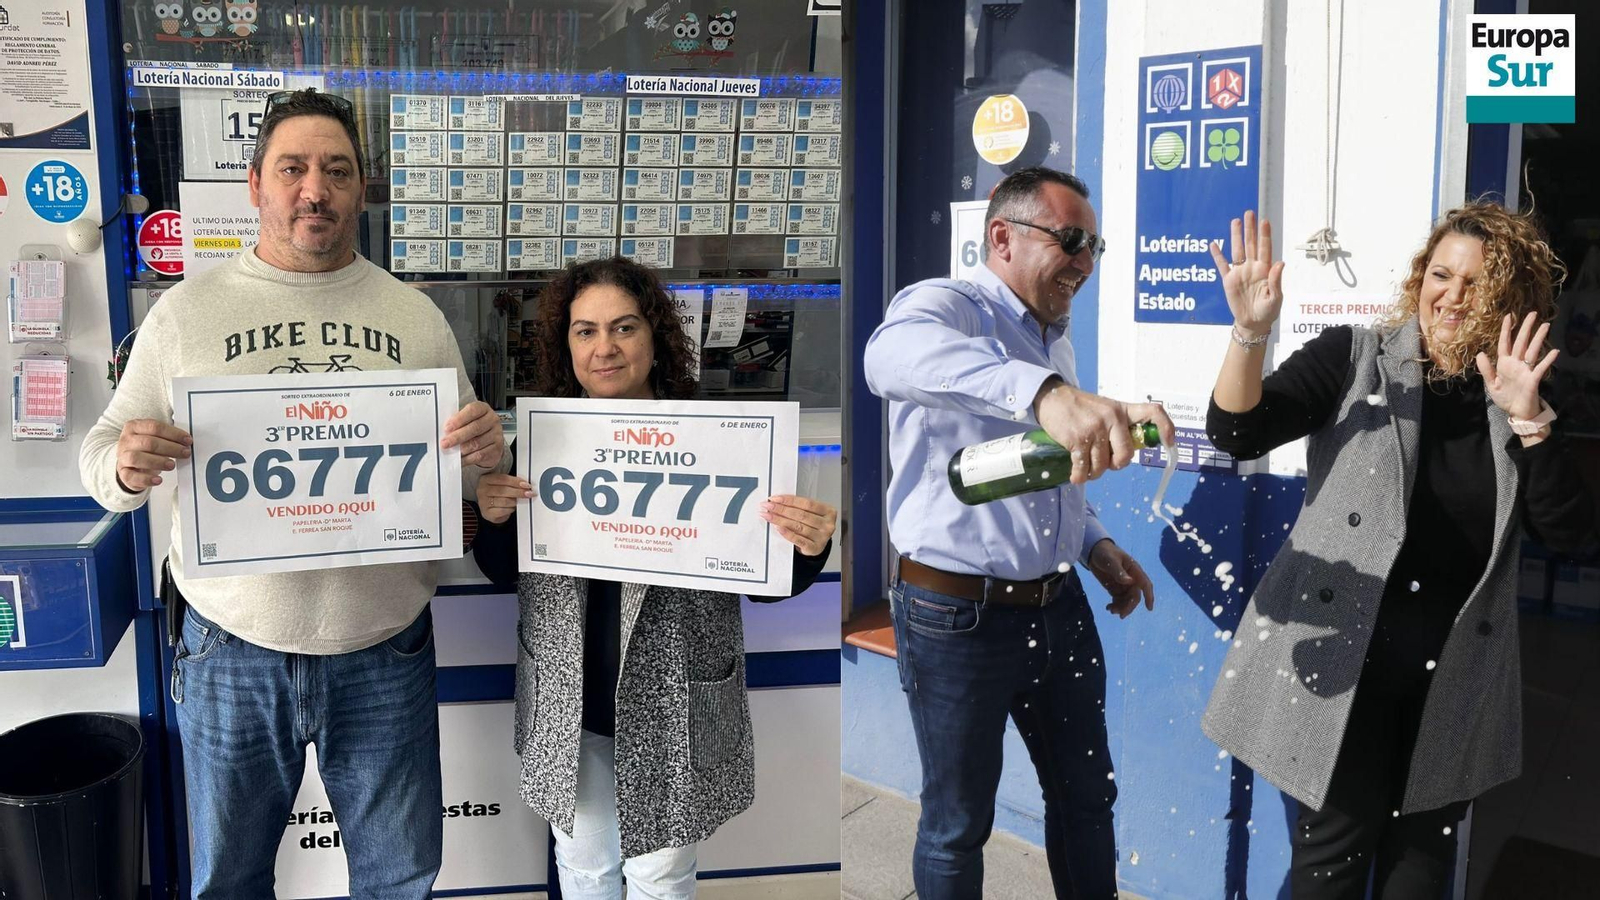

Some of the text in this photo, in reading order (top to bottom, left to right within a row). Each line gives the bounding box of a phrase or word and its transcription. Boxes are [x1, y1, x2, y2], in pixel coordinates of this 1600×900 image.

[138, 70, 280, 87] Lotería Nacional Sábado
[627, 78, 756, 94] Lotería Nacional Jueves
[984, 101, 1014, 124] +18
[228, 112, 262, 139] 15
[215, 161, 247, 170] Lotería
[32, 176, 74, 201] +18
[74, 176, 83, 200] AÑOS
[151, 218, 182, 238] +18
[1140, 234, 1208, 253] Loterías
[1138, 264, 1216, 285] Apuestas
[1138, 292, 1195, 310] Estado
[1300, 304, 1343, 314] TERCER
[680, 316, 694, 324] OR
[225, 322, 401, 364] BIKE CLUB
[286, 401, 347, 421] El Niño
[1167, 403, 1196, 411] Loterías
[287, 423, 370, 441] PREMIO
[614, 427, 675, 447] El Niño
[613, 449, 696, 467] PREMIO
[205, 443, 428, 502] 66777
[539, 466, 758, 524] 66777
[266, 503, 334, 517] VENDIDO
[591, 521, 698, 540] VENDIDO AQUÍ
[300, 831, 340, 849] del
